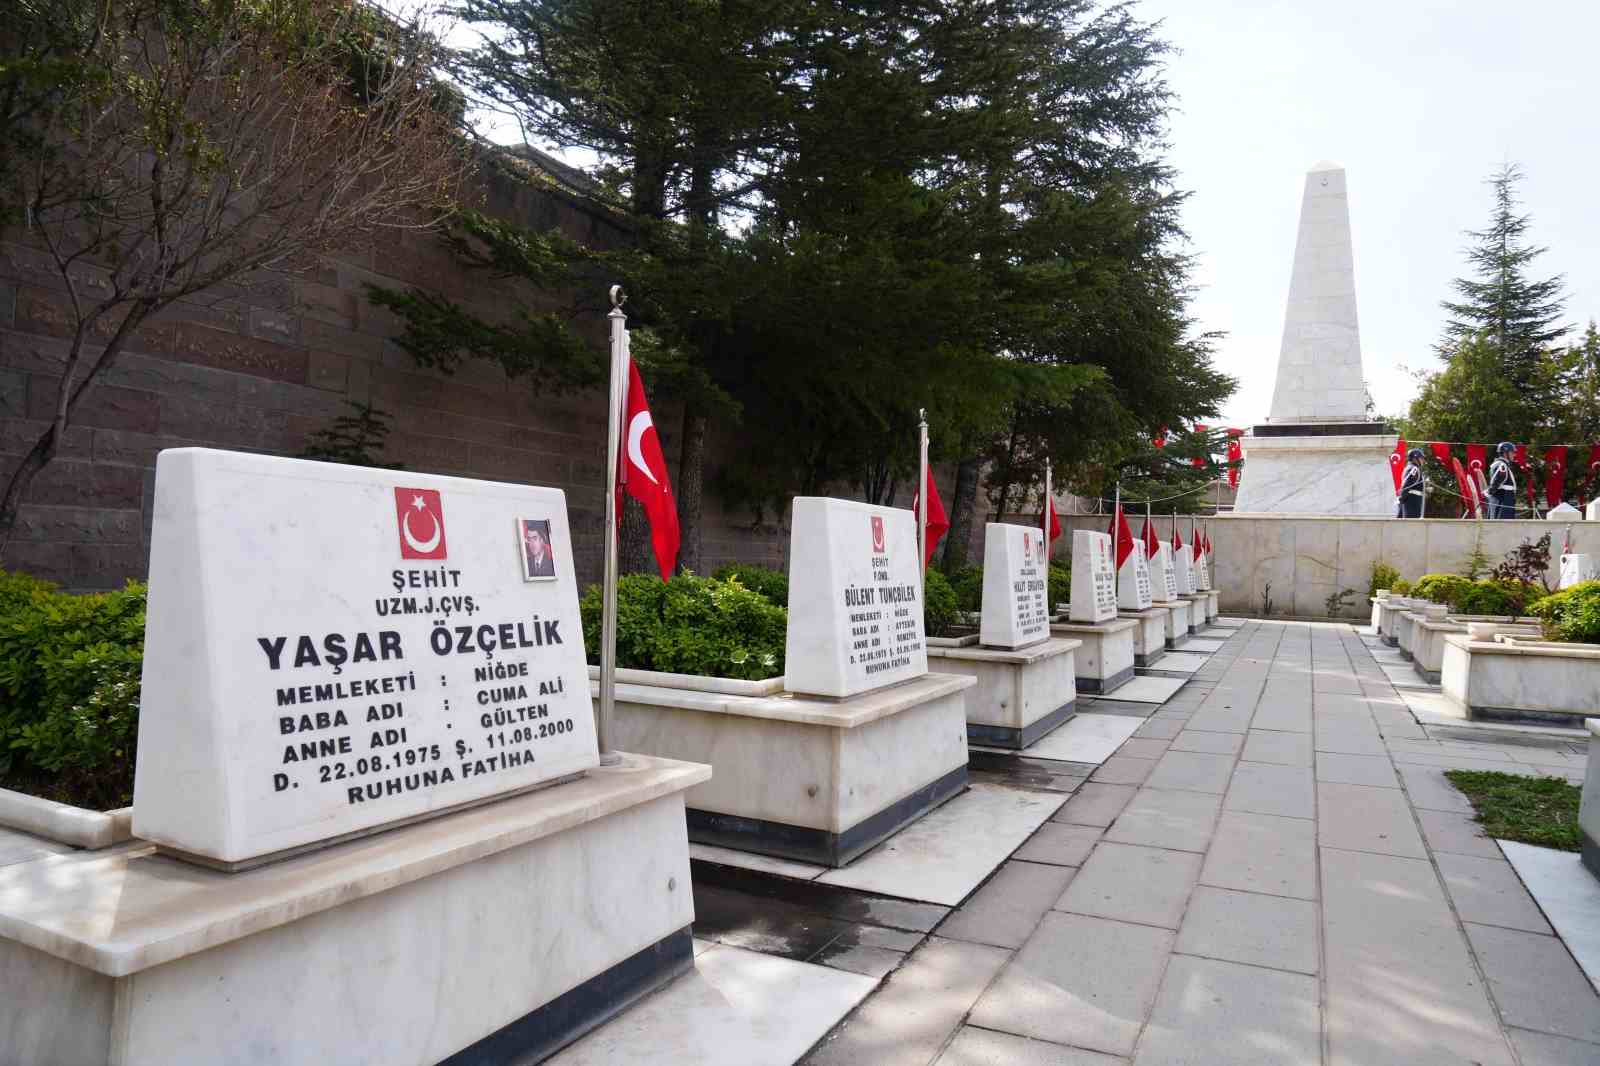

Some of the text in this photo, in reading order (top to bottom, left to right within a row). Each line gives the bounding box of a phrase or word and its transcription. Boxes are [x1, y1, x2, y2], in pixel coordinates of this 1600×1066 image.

[376, 595, 480, 617] UZM.J.ÇVŞ.
[392, 565, 461, 594] ŞEHİT
[845, 584, 874, 607] BÜLENT
[257, 614, 563, 676] YAŞAR ÖZÇELİK
[277, 670, 416, 706] MEMLEKETİ
[475, 661, 529, 682] NİĞDE
[280, 710, 349, 735] BABA
[366, 702, 404, 722] ADI
[477, 685, 528, 705] CUMA
[539, 676, 563, 696] ALİ
[273, 718, 575, 793] D. 22.08.1975 Ş. 11.08.2000
[282, 736, 353, 765] ANNE
[370, 728, 407, 749] ADI
[480, 703, 549, 729] GÜLTEN
[348, 749, 536, 805] RUHUNA FATİHA
